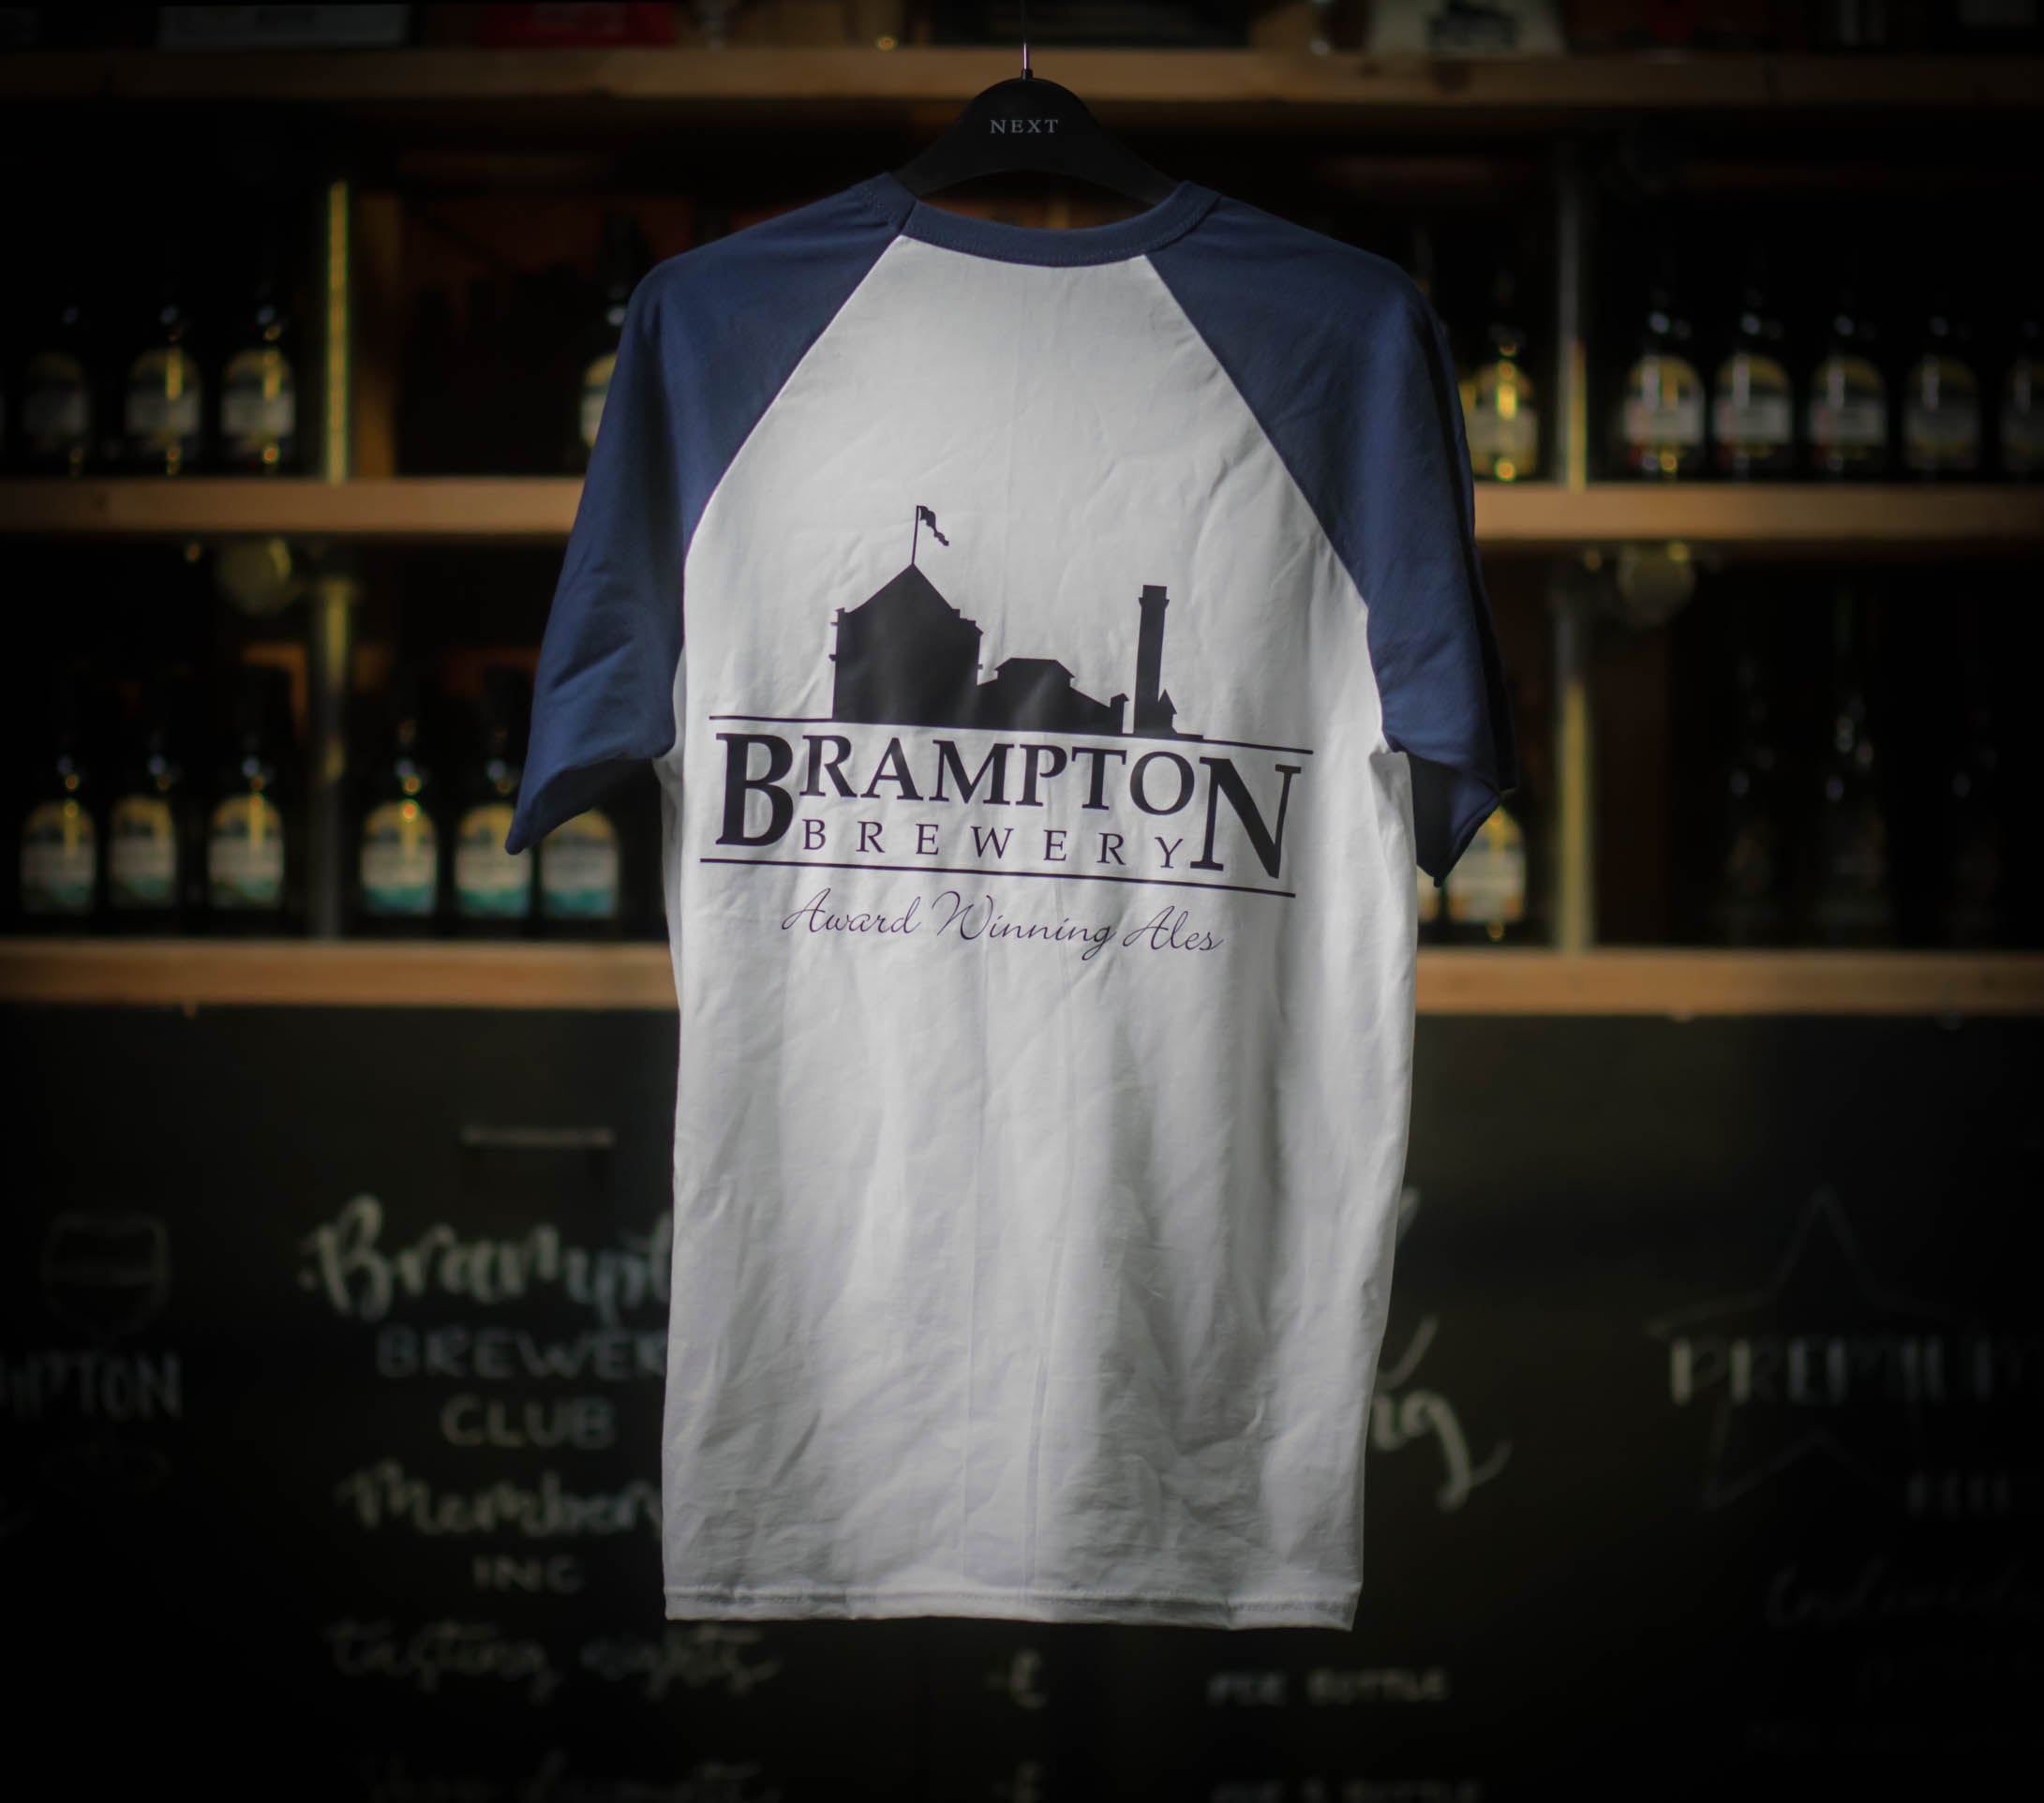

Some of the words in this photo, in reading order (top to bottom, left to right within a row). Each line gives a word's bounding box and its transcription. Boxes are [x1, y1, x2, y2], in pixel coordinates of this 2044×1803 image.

[989, 119, 1059, 135] NEXT
[715, 733, 1302, 879] BRAMPTON
[800, 818, 1184, 870] BREWERY
[781, 887, 921, 936] Award
[930, 890, 1115, 961] Winning
[1121, 904, 1225, 952] Ales
[439, 1393, 616, 1451] CLUB
